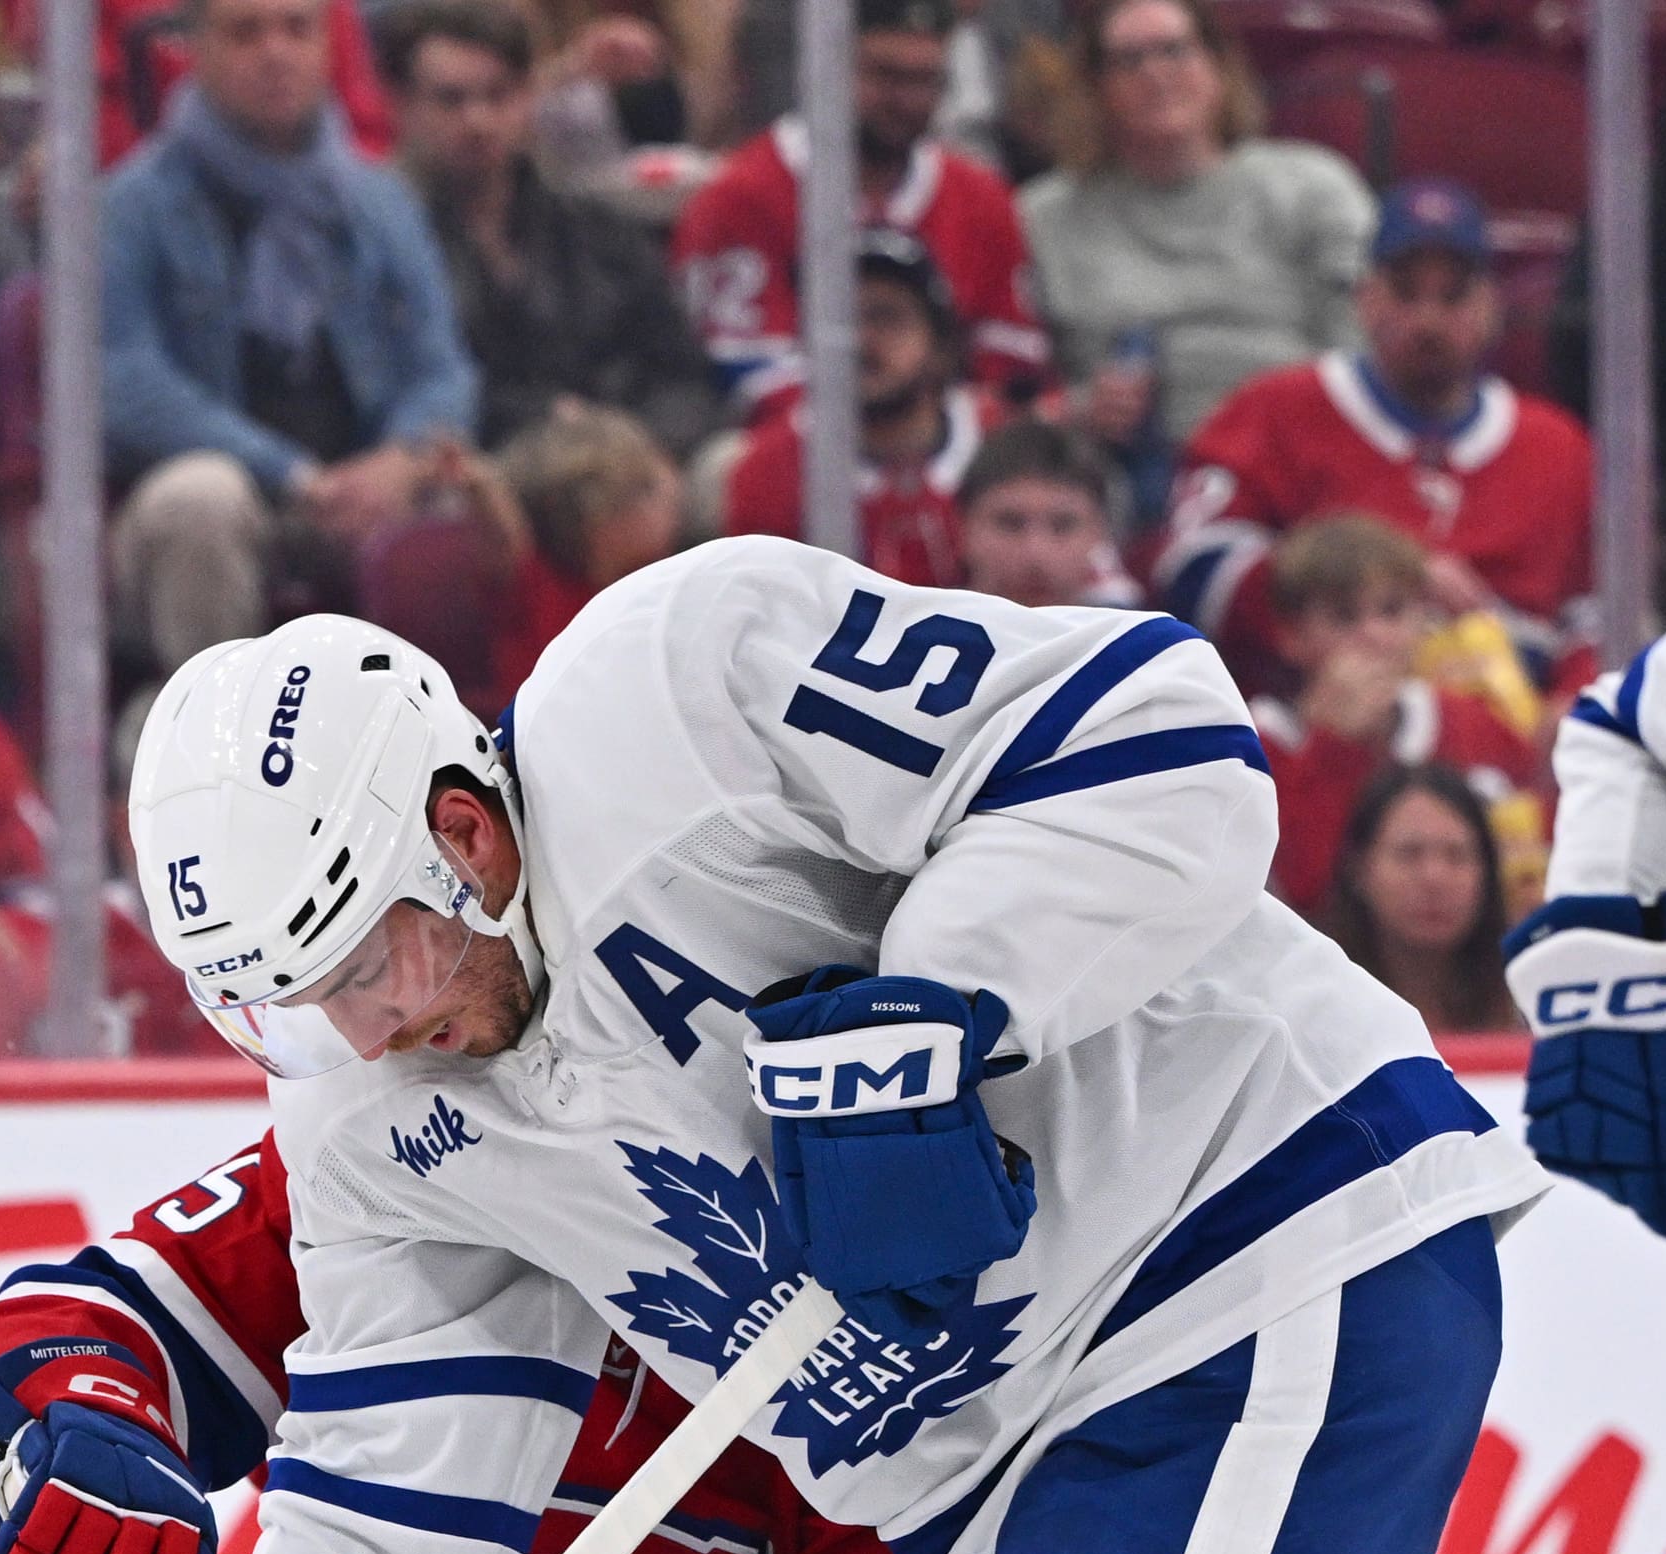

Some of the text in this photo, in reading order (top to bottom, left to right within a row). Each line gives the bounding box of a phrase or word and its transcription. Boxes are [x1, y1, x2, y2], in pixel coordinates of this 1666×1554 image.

[784, 588, 996, 779] 15
[261, 665, 311, 787] OREO
[168, 855, 208, 921] 15
[194, 948, 264, 977] CCM
[593, 921, 755, 1067] A
[870, 1002, 921, 1013] SISSONS
[744, 1048, 933, 1111] CM
[30, 1345, 109, 1360] MITTELSTADT
